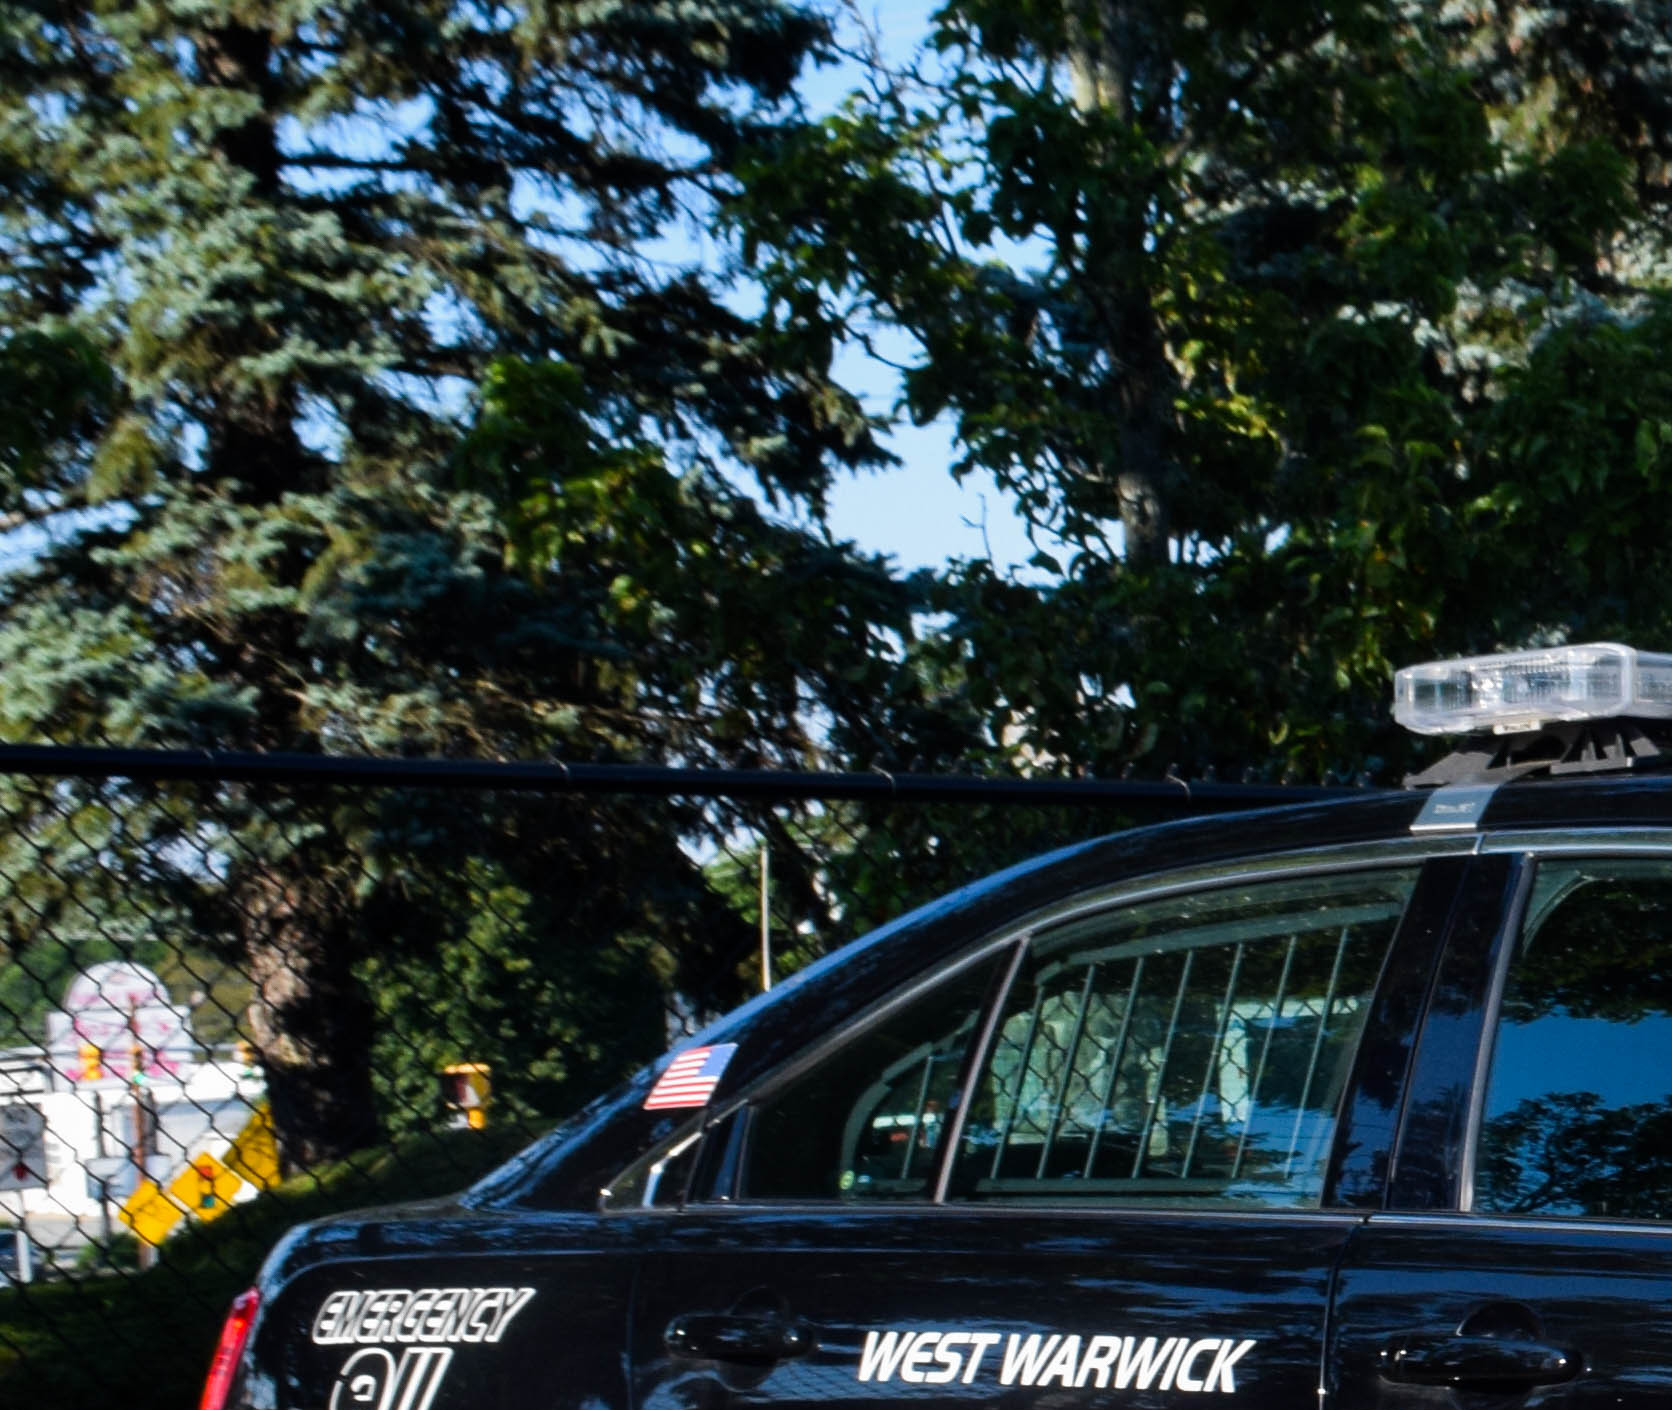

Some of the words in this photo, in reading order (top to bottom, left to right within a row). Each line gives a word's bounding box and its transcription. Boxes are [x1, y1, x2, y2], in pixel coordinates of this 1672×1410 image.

[313, 1288, 536, 1344] EMERGENCY
[858, 1331, 1000, 1384] WEST
[1001, 1333, 1256, 1393] WARWICK
